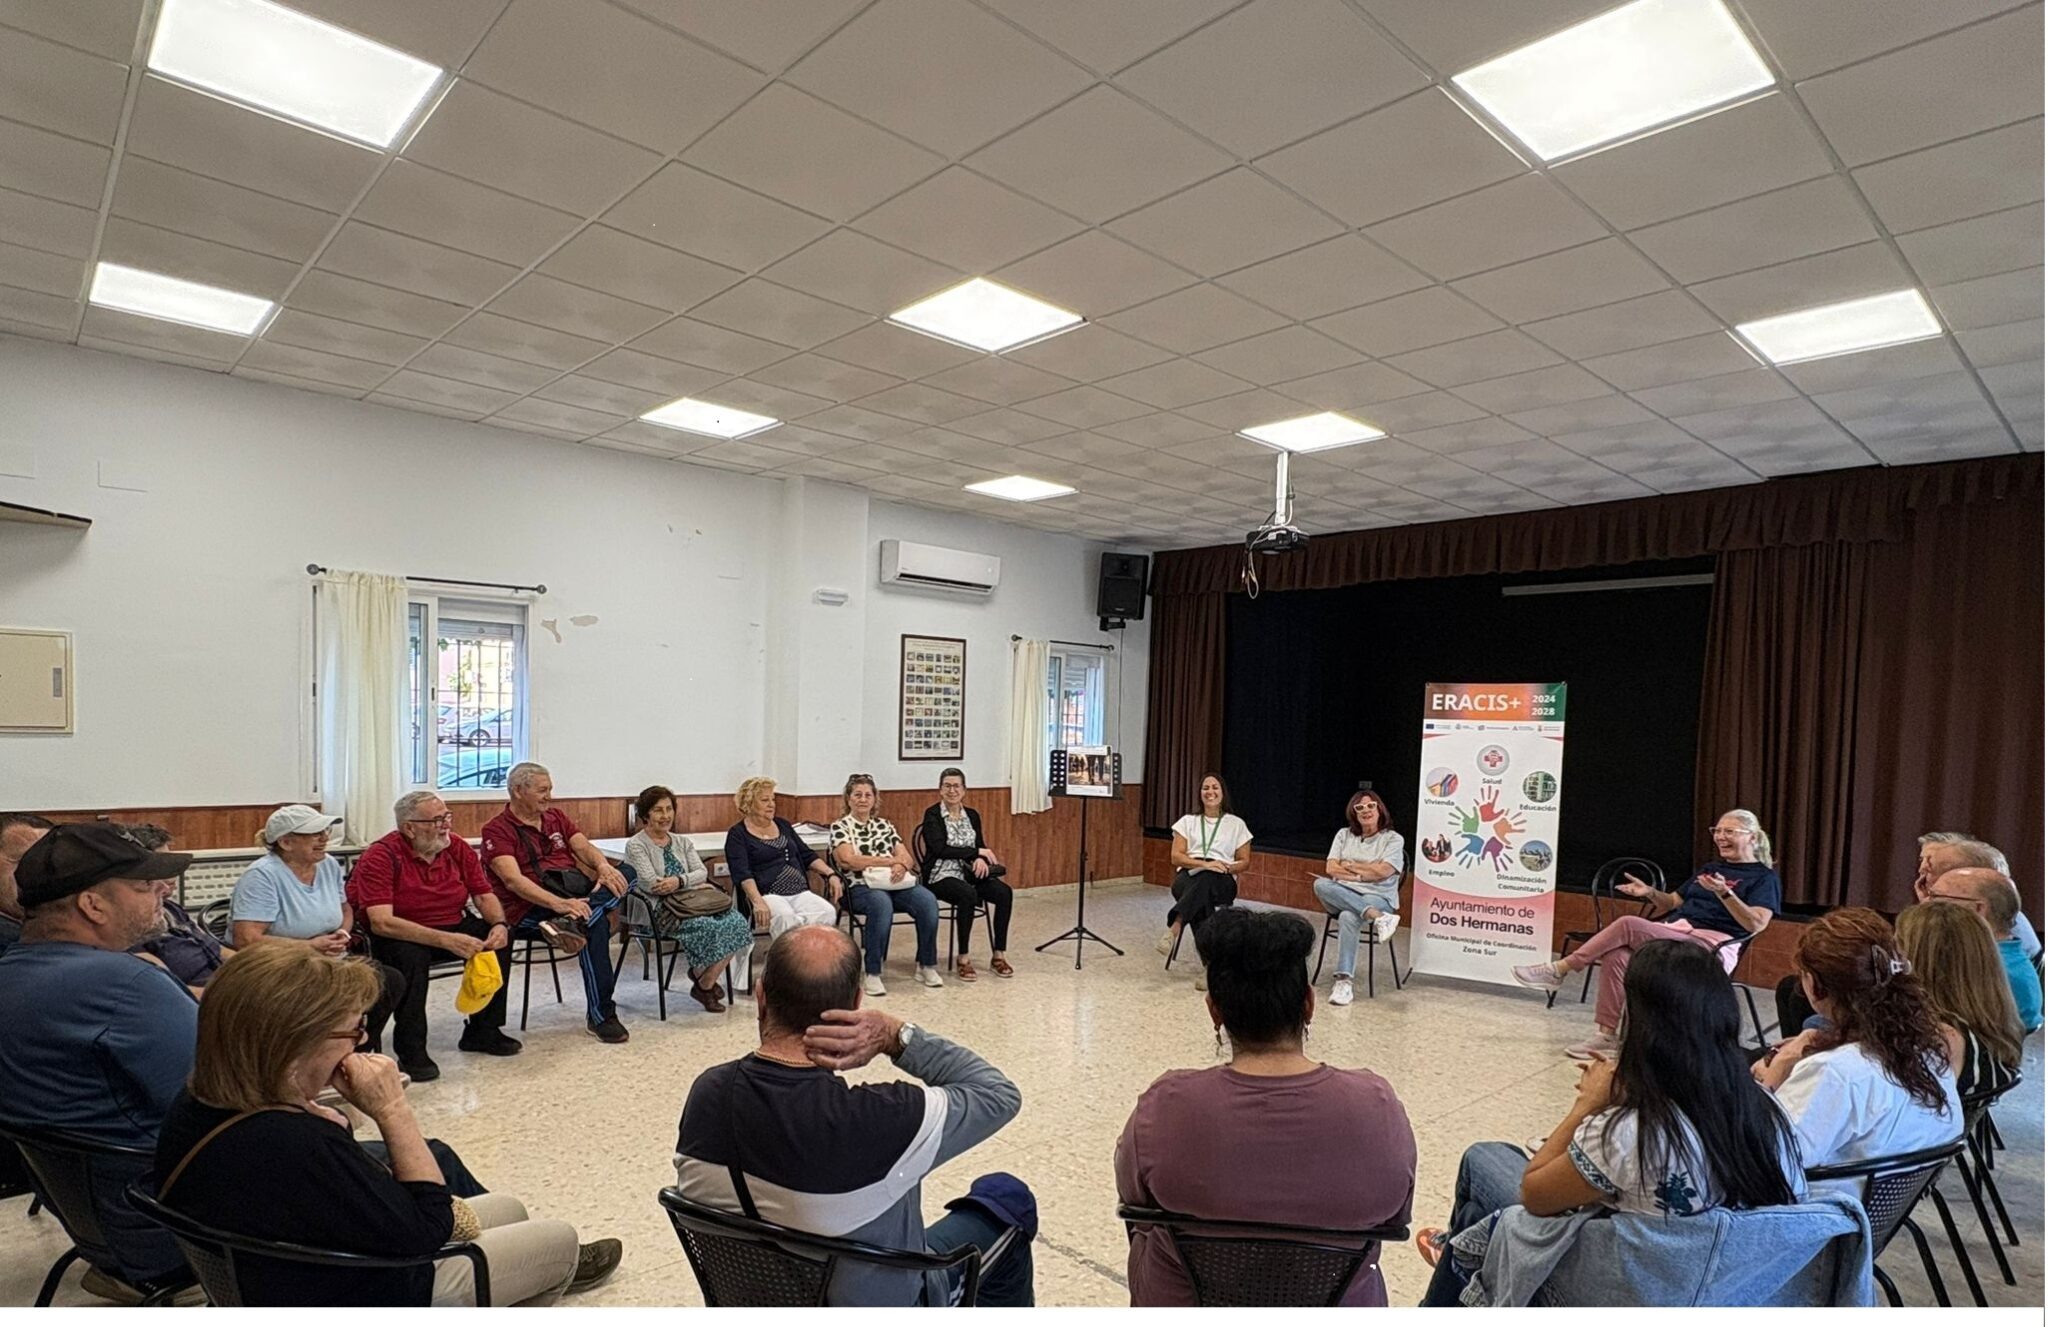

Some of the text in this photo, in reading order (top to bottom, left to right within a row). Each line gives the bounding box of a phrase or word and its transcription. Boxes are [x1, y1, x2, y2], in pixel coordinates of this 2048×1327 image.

[1432, 693, 1521, 711] ERACIS+
[1531, 695, 1556, 703] 2024
[1531, 707, 1555, 716] 2028
[1424, 799, 1455, 807] Vivienda
[1519, 804, 1557, 812] Educación
[1428, 869, 1455, 877] Empleo
[1496, 873, 1547, 884] Dinamización
[1498, 883, 1544, 893] Comunitaria
[1430, 897, 1535, 919] Ayuntamiento de
[1430, 912, 1534, 936] Dos Hermanas
[1426, 932, 1449, 941] Oficina
[1450, 935, 1482, 945] Municipal
[1493, 941, 1537, 952] Coordinación
[1463, 946, 1497, 957] Zona Sur
